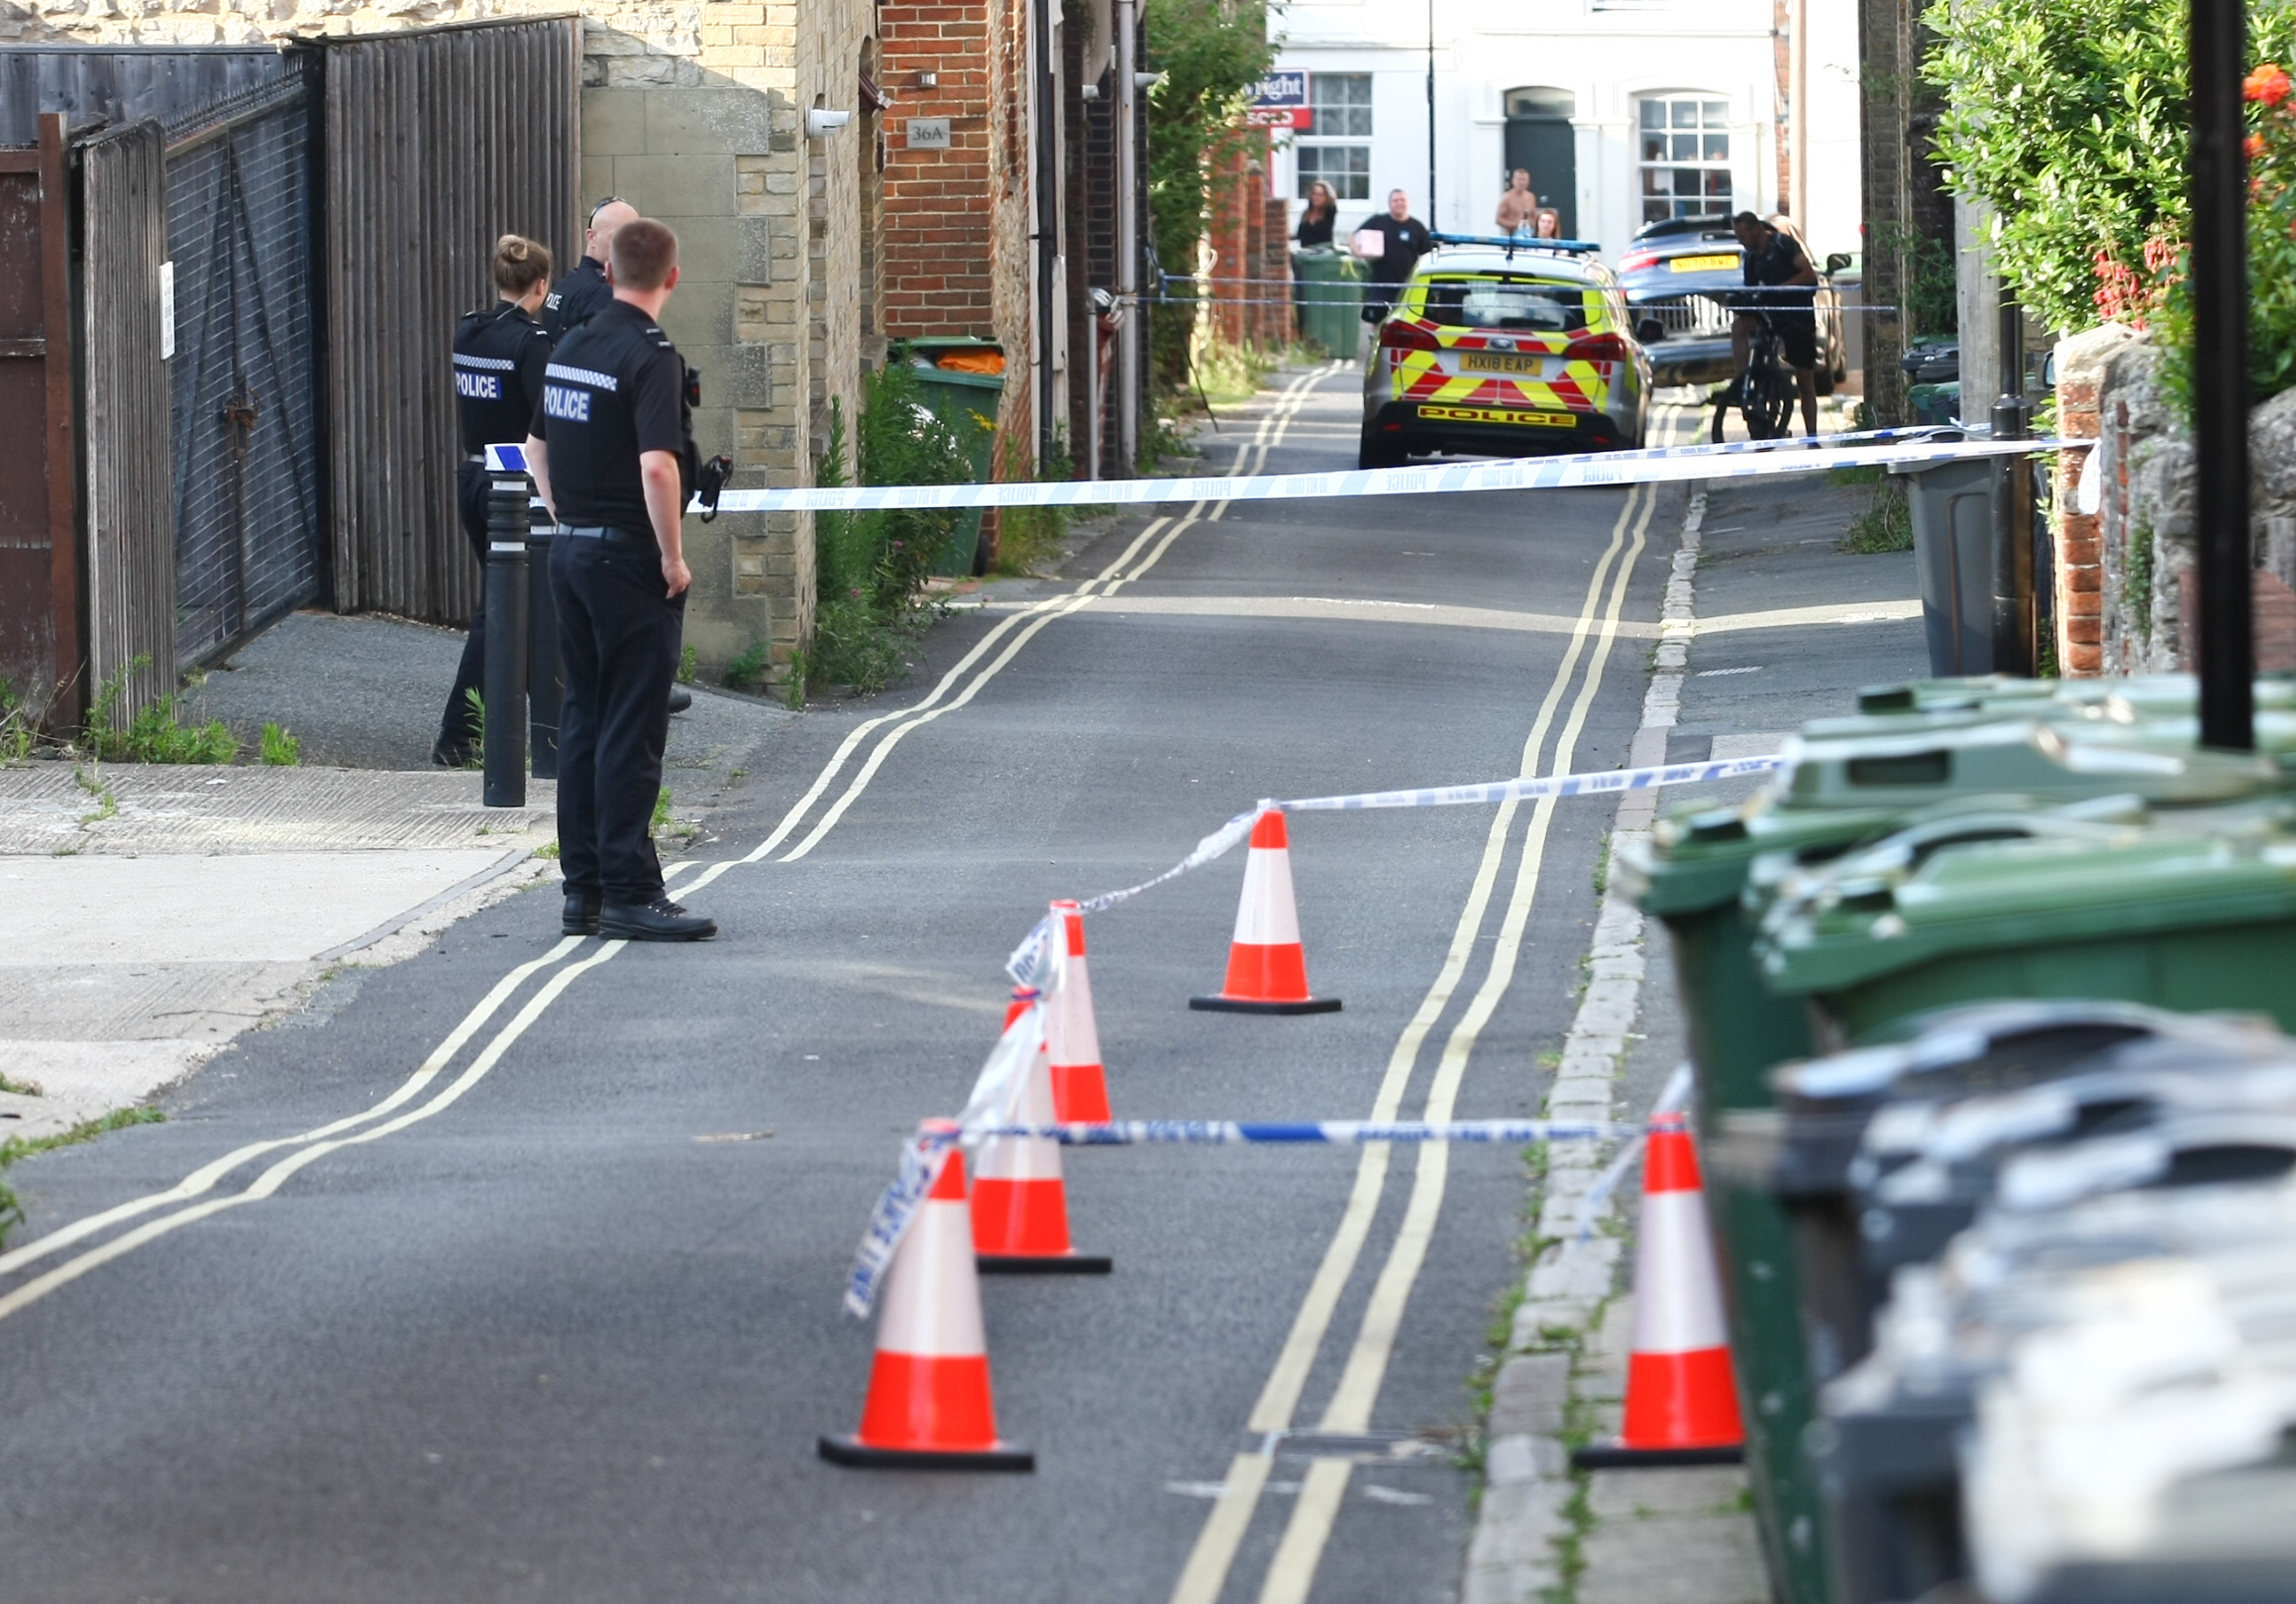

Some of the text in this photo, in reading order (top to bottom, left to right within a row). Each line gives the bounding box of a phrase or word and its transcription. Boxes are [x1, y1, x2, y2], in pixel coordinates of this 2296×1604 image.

[912, 126, 943, 141] 36A
[1468, 355, 1533, 373] HX18 EAP
[1419, 407, 1575, 425] POLICE
